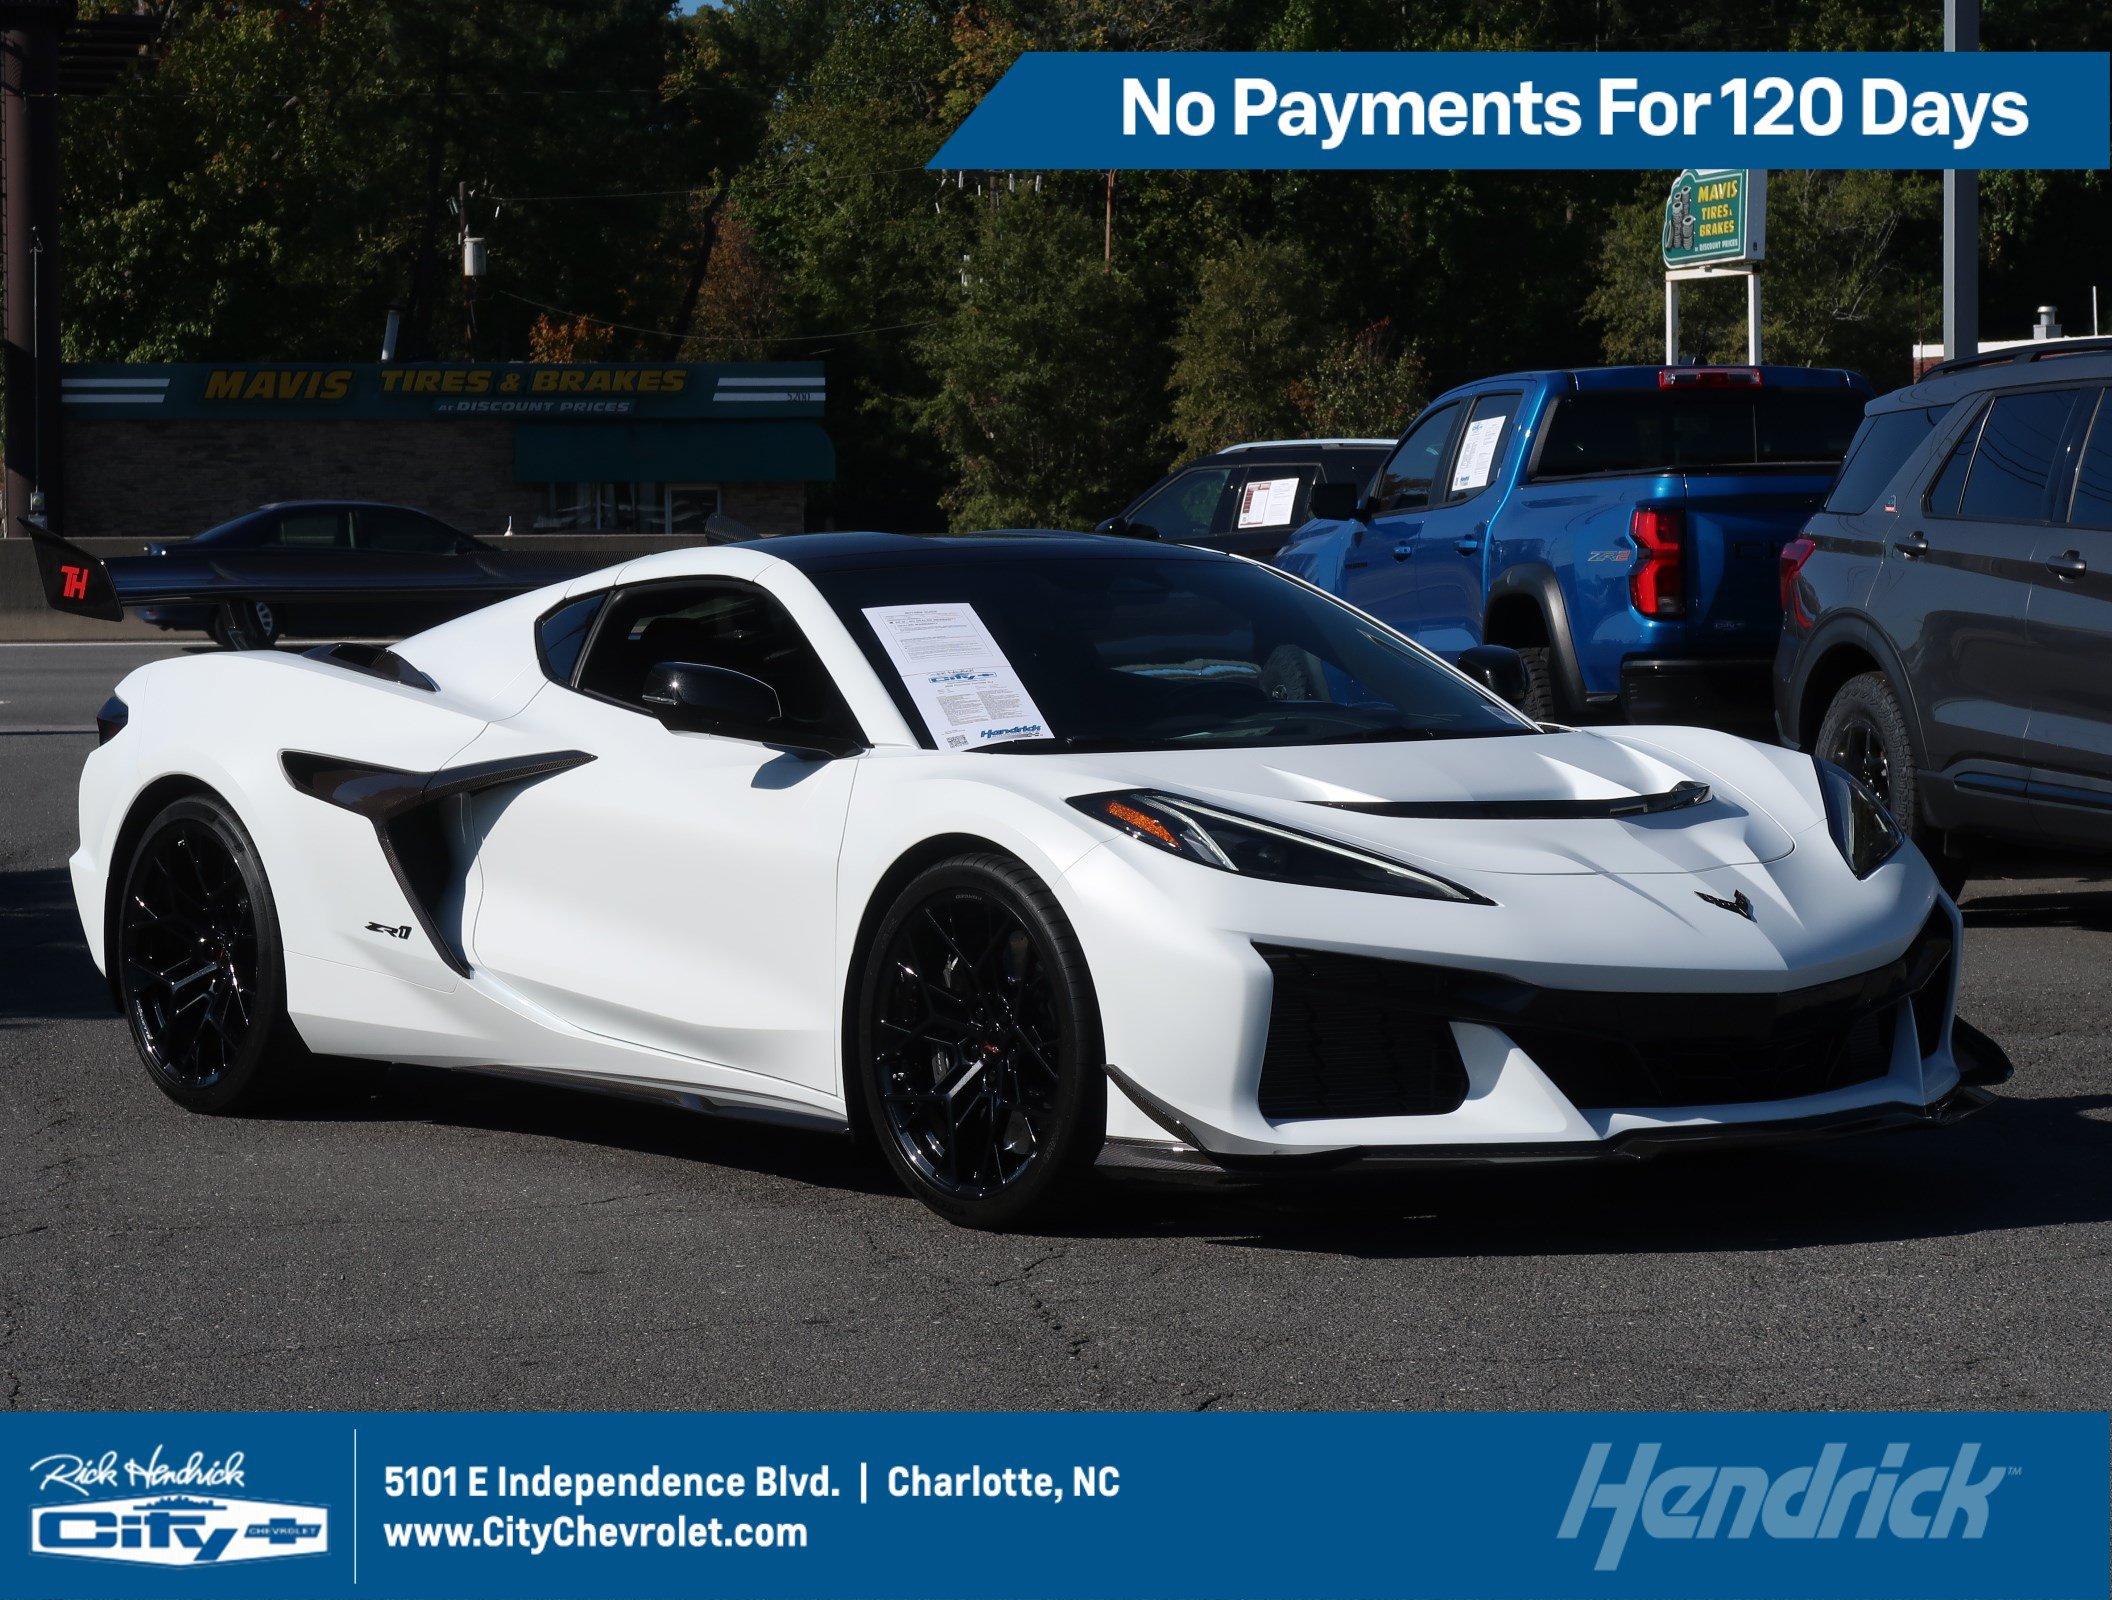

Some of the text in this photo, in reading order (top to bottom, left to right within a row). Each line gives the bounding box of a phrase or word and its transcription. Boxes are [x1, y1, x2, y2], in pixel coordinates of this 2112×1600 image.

[1697, 180, 1738, 203] MAVIS
[1701, 203, 1729, 220] TIRES
[1700, 220, 1735, 237] BRAKES
[204, 370, 352, 399] MAVIS
[380, 369, 688, 392] TIRES & BRAKES
[456, 401, 555, 412] DISCOUNT
[559, 401, 631, 413] PRICES
[980, 725, 1041, 738] Hendrick
